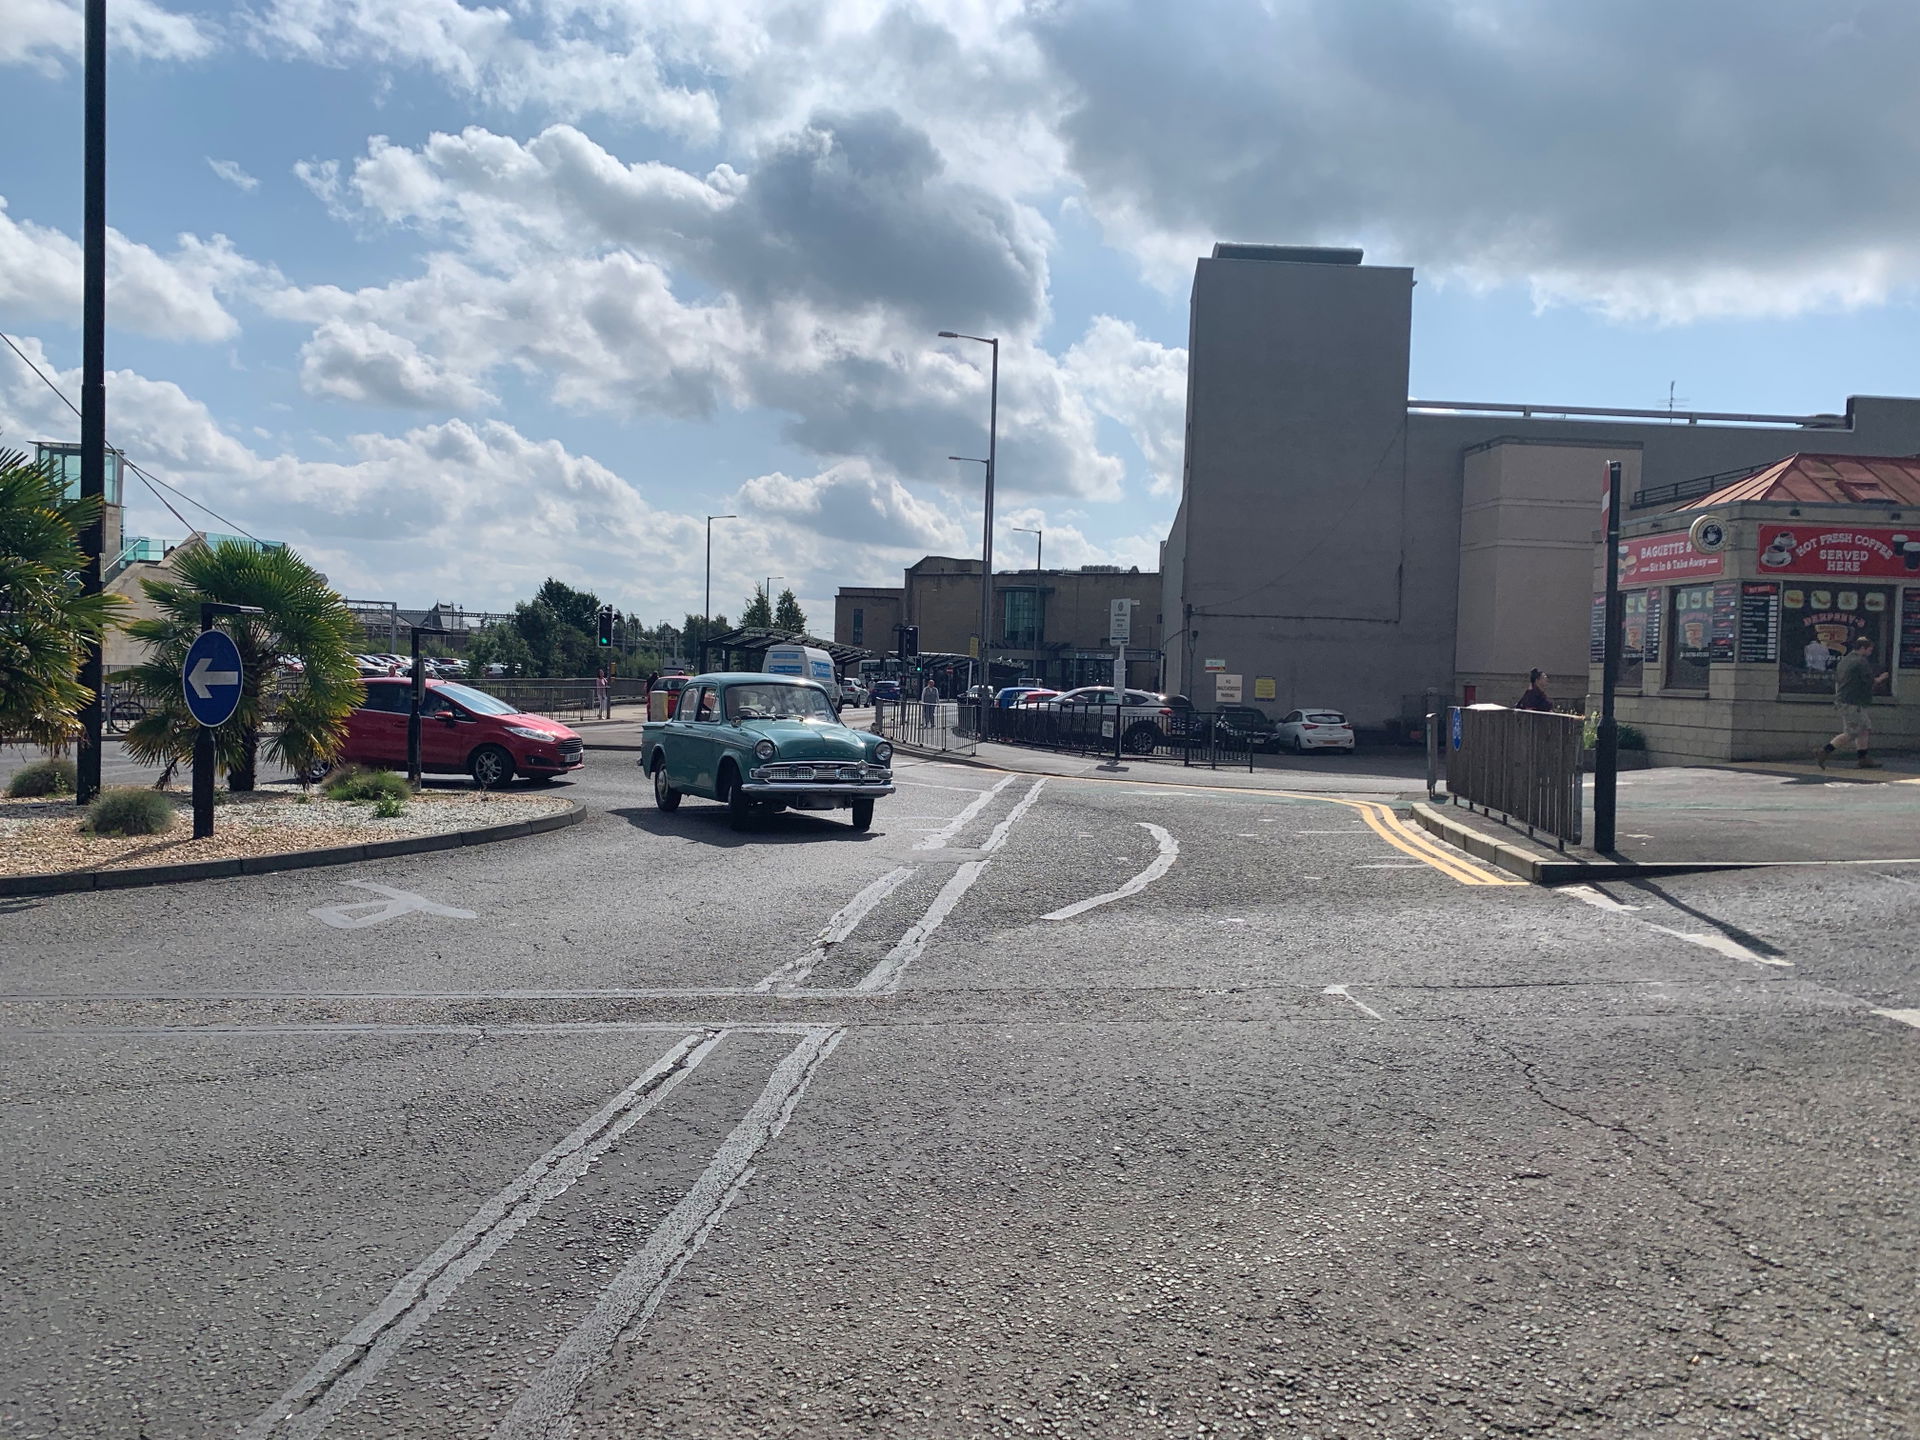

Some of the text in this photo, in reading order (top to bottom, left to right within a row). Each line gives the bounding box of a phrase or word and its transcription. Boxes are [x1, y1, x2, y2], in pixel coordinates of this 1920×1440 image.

[1641, 542, 1685, 559] BAGUETTE
[1795, 533, 1894, 560] HOT FRESH COFFEE
[1819, 549, 1869, 561] SERVED
[1826, 561, 1861, 572] HERE
